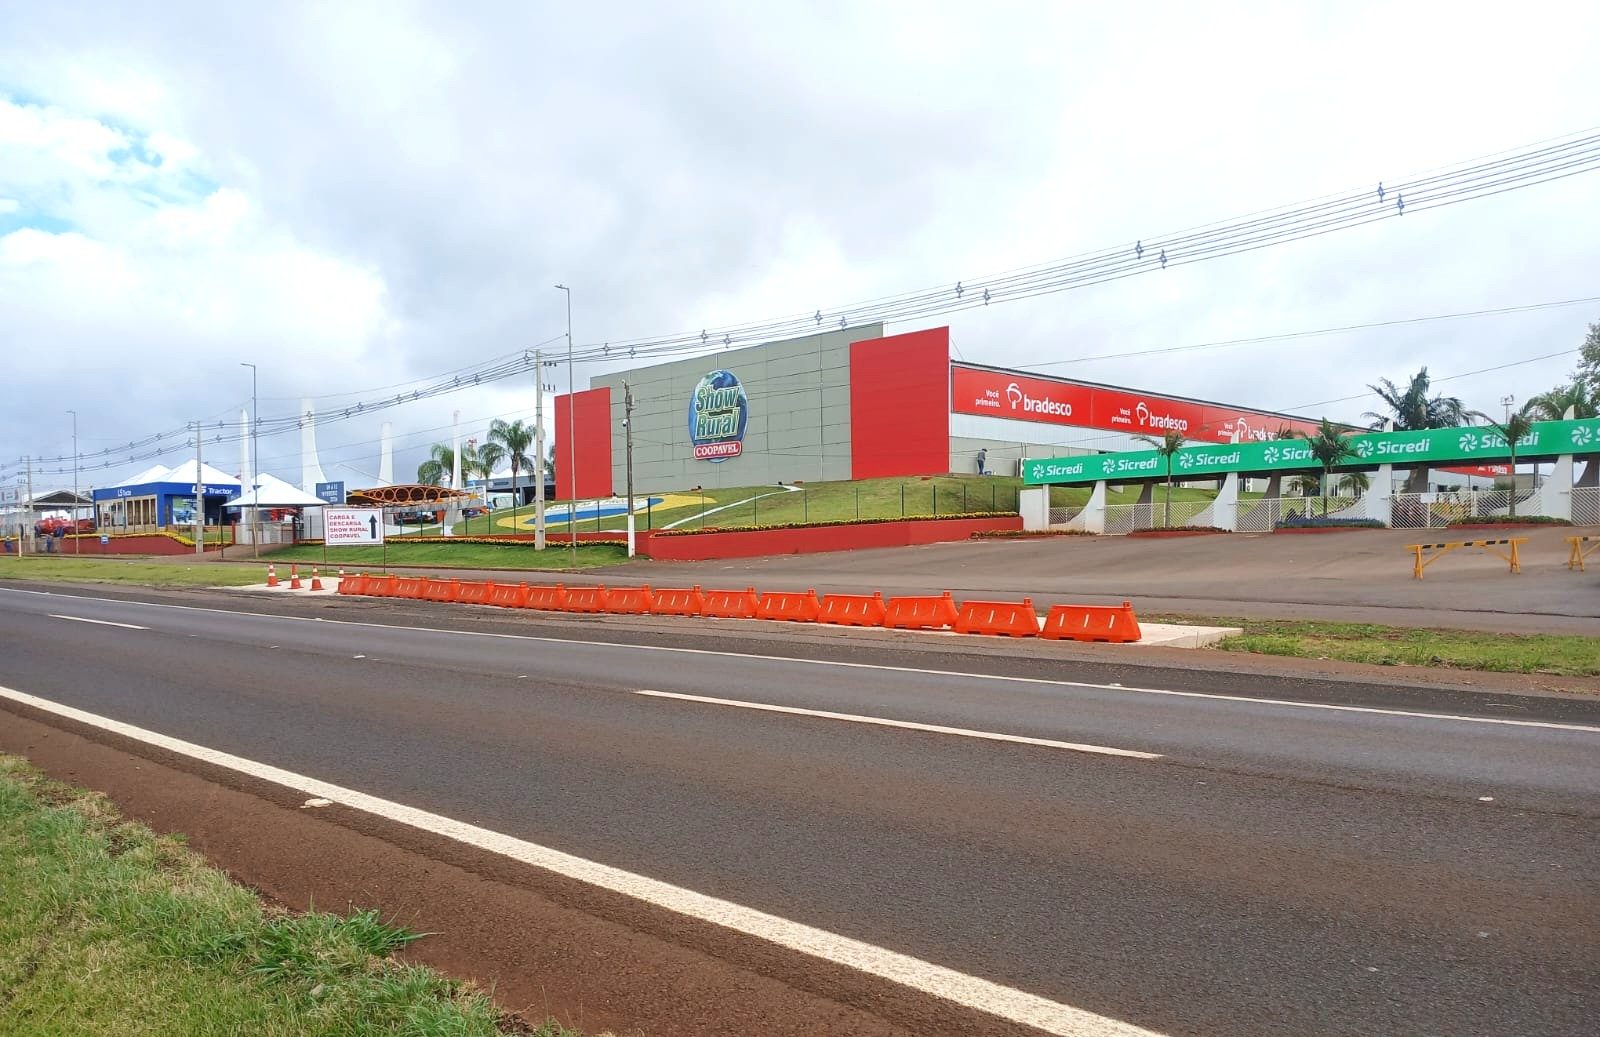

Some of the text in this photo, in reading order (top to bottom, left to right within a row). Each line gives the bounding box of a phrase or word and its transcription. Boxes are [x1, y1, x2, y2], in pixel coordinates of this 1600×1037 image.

[696, 385, 740, 412] Show
[985, 389, 999, 398] Você
[1024, 394, 1072, 416] bradesco
[695, 408, 740, 440] Rural
[1150, 411, 1188, 431] bradesco
[1248, 424, 1278, 441] bradesc
[1480, 431, 1539, 449] Sicedi
[696, 443, 739, 457] COOPAVEL
[1282, 447, 1314, 460] Sicr
[1376, 438, 1430, 454] Sicredi
[1117, 457, 1158, 471] Sicredi
[1195, 451, 1240, 466] Sicredi
[1046, 463, 1083, 476] Sicredi
[207, 487, 233, 495] Tractor
